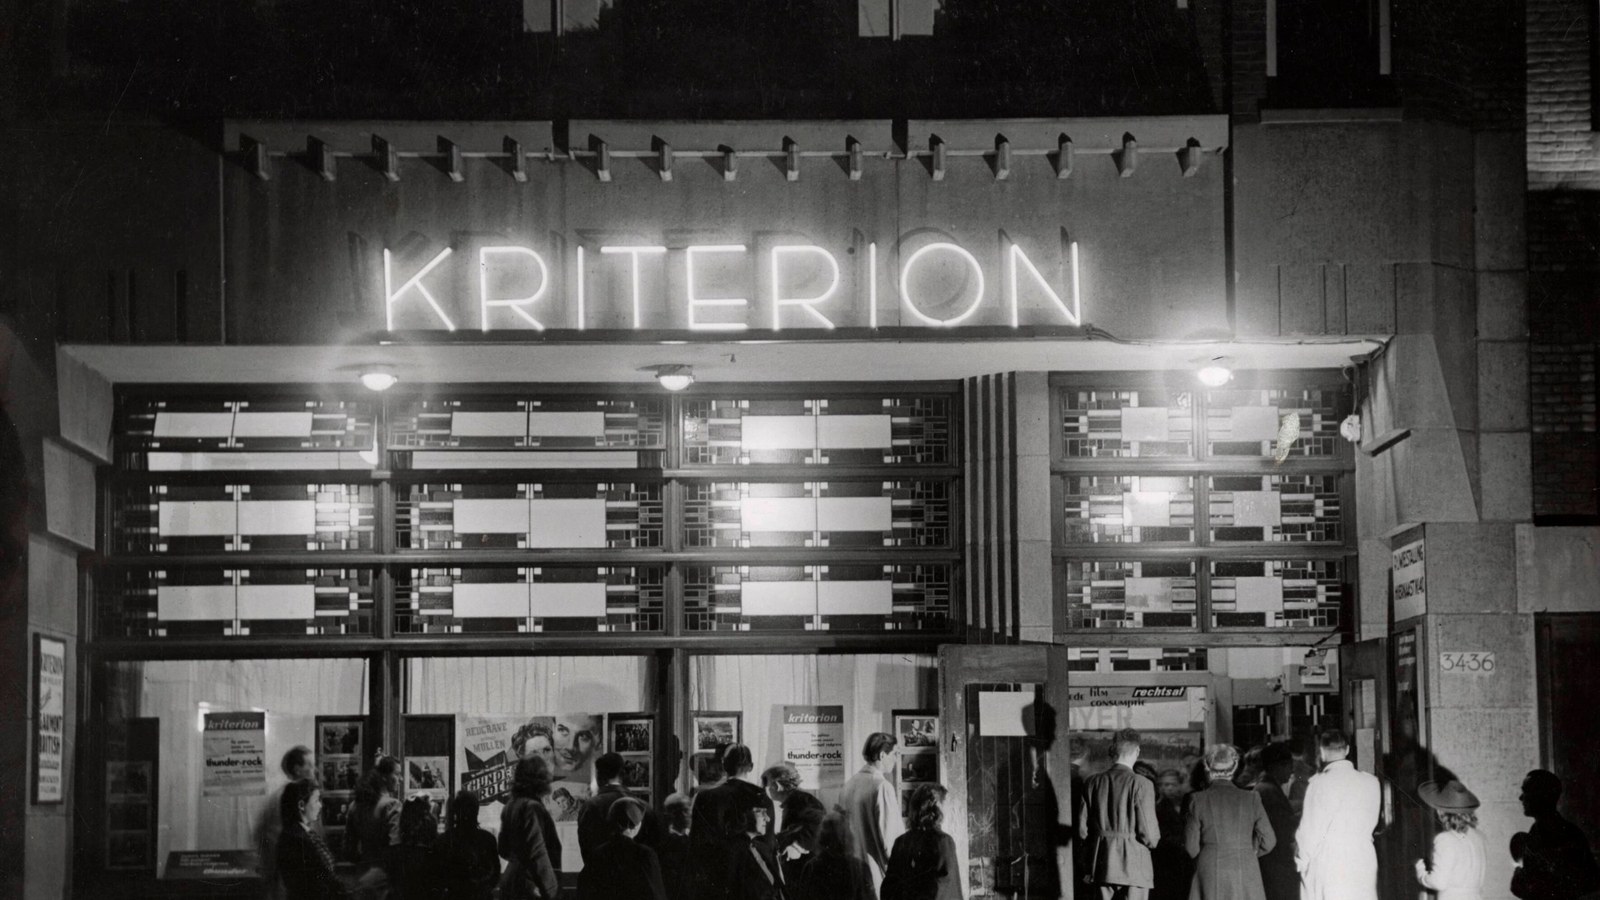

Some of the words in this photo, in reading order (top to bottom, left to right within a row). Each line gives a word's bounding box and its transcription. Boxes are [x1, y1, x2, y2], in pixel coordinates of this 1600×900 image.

[383, 241, 1081, 332] KRITERION
[1441, 653, 1495, 672] 34-36
[788, 713, 837, 723] kriterion
[208, 719, 259, 729] kriterion
[787, 750, 842, 760] thunder-rock
[206, 756, 263, 767] thunder-rock
[464, 766, 514, 792] THUND
